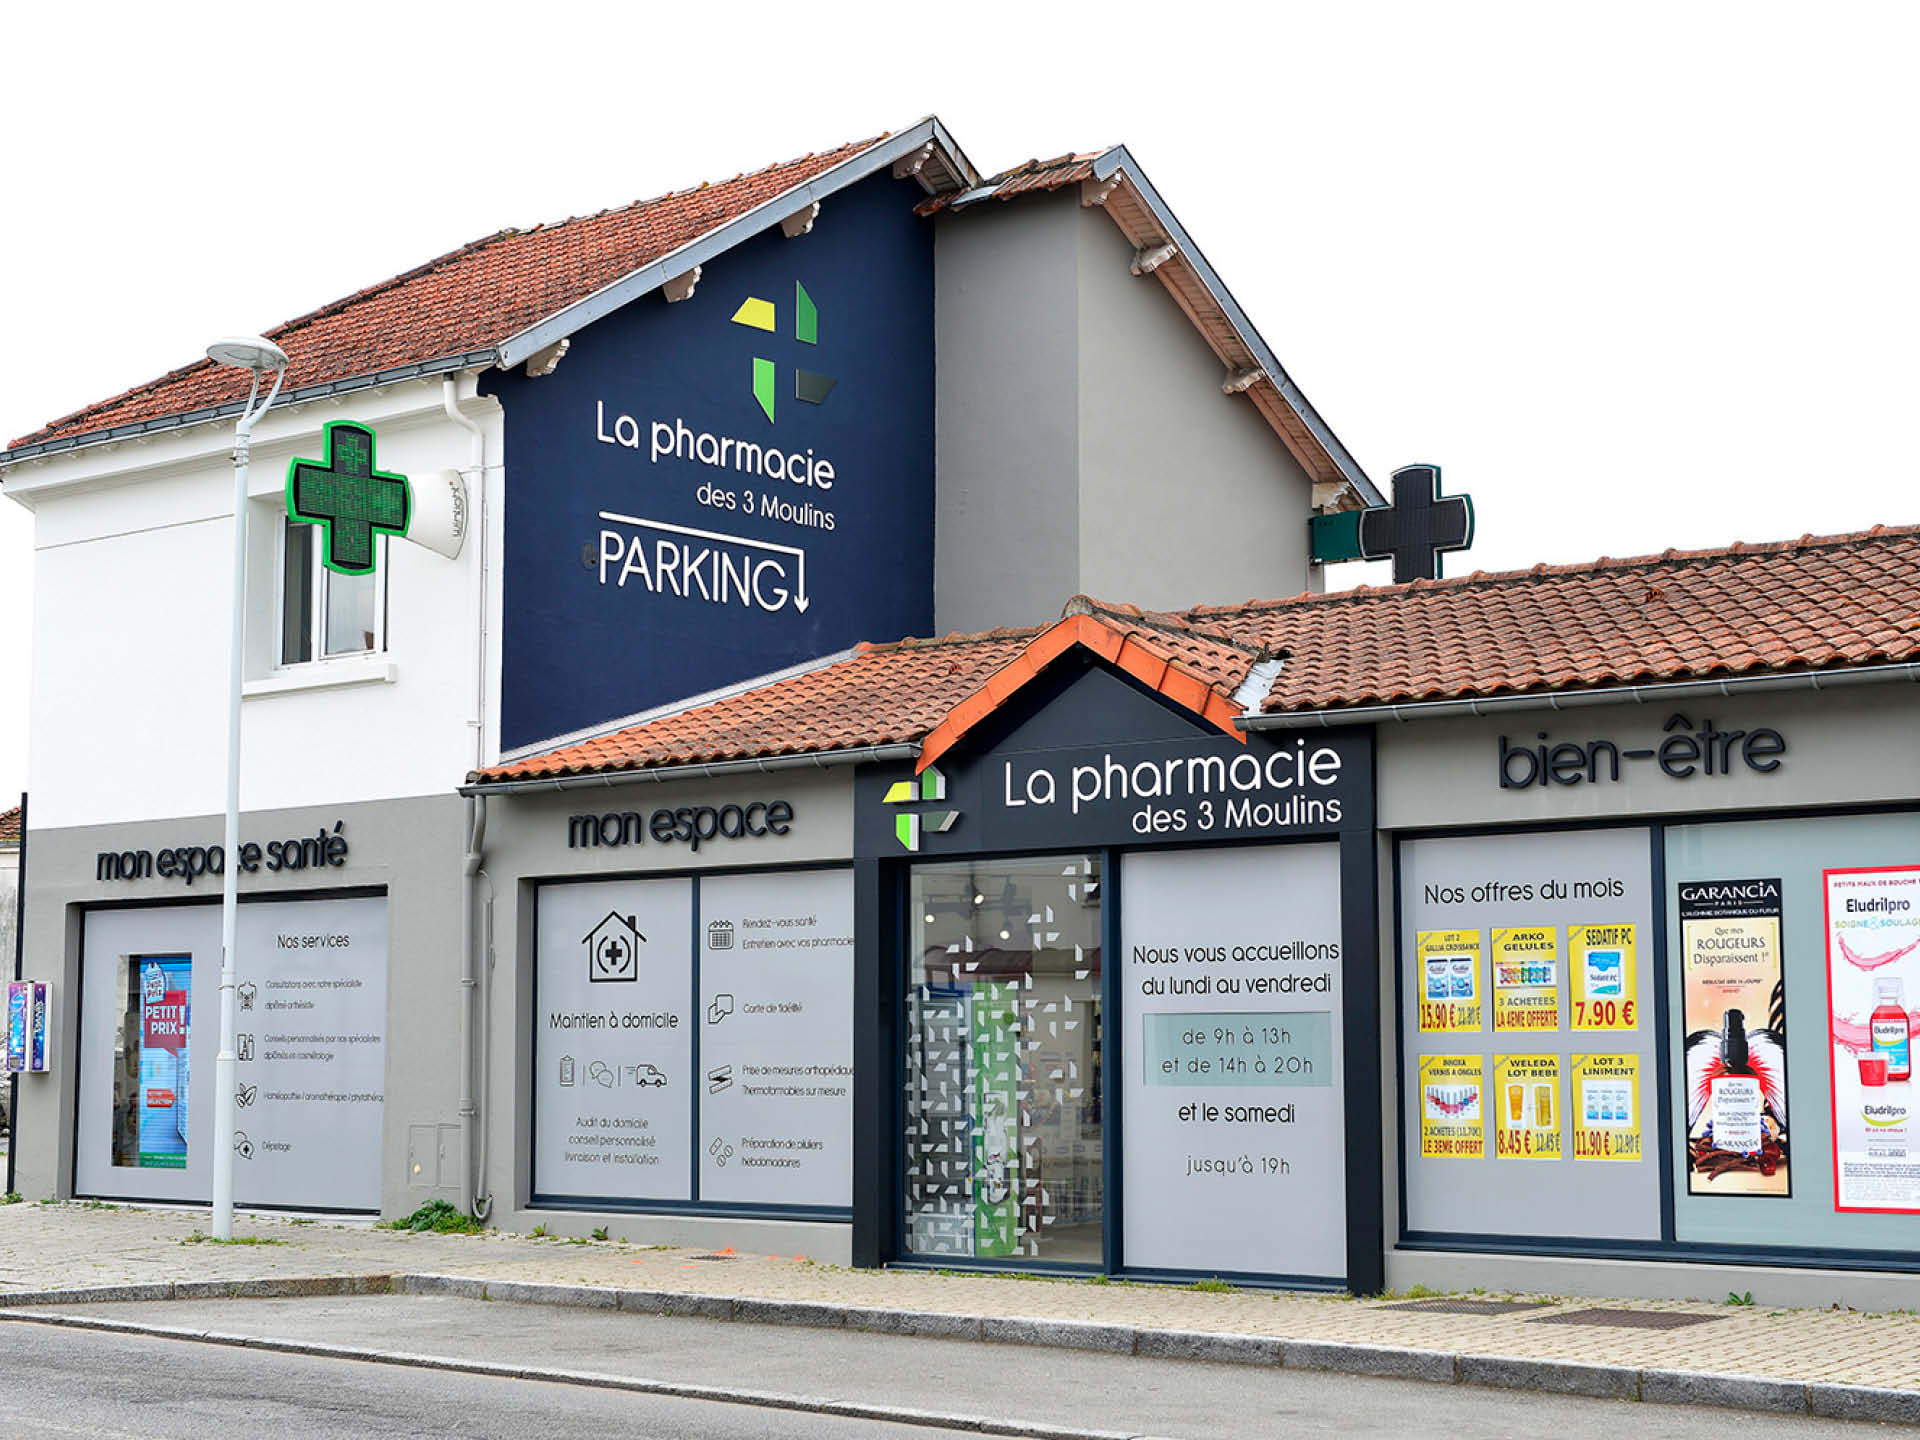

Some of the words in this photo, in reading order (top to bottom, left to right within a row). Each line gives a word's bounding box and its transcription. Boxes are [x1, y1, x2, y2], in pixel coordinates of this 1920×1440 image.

[597, 400, 639, 449] La
[650, 418, 836, 490] pharmacie
[697, 482, 736, 511] des
[743, 491, 755, 514] 3
[761, 494, 835, 531] Moulins
[600, 530, 788, 612] PARKING
[1499, 713, 1787, 789] bien-être
[1005, 761, 1055, 807] La
[1072, 738, 1342, 815] pharmacie
[1132, 804, 1187, 834] des
[1197, 801, 1215, 830] 3
[1225, 794, 1343, 829] Moulins
[568, 812, 642, 848] mon
[650, 800, 794, 851] espace
[97, 849, 152, 880] mon
[156, 842, 262, 885] espae
[266, 820, 348, 871] santé
[1424, 884, 1465, 905] Nos
[1471, 881, 1534, 903] offres
[1540, 879, 1567, 900] du
[1574, 877, 1625, 898] mois
[1846, 897, 1911, 915] Eludrilpro
[277, 934, 299, 949] Nos
[301, 933, 350, 948] services
[1504, 942, 1554, 951] GELULES
[1513, 933, 1545, 941] ARKO
[1586, 928, 1619, 946] SEDATIF
[1621, 927, 1632, 945] PC
[1697, 937, 1766, 950] ROUGEURS
[1133, 945, 1179, 964] Nous
[1184, 945, 1227, 963] vous
[1232, 941, 1340, 962] accueillons
[1141, 977, 1165, 995] du
[1169, 976, 1211, 994] lundi
[1216, 978, 1241, 994] au
[1245, 973, 1332, 993] vendredi
[1507, 997, 1556, 1006] ACHETEES
[146, 1005, 177, 1019] PETIT
[550, 1012, 605, 1029] Maintien
[608, 1011, 618, 1029] à
[622, 1012, 679, 1029] domicile
[1421, 1003, 1448, 1028] 15.90
[1449, 1003, 1456, 1028] €
[1496, 1011, 1505, 1028] LA
[1507, 1011, 1525, 1027] 4EME
[1527, 1010, 1558, 1028] OFFERTE
[1576, 1000, 1616, 1026] 7.90
[1622, 1000, 1634, 1026] €
[151, 1021, 177, 1035] PRIX
[1182, 1029, 1206, 1045] de
[1213, 1028, 1235, 1045] 9h
[1242, 1025, 1254, 1044] à
[1261, 1028, 1291, 1044] 13h
[1161, 1057, 1179, 1074] et
[1187, 1057, 1211, 1074] de
[1219, 1057, 1248, 1073] 14h
[1254, 1054, 1266, 1073] à
[1274, 1057, 1313, 1074] 20h
[1510, 1059, 1555, 1067] WELEDA
[1593, 1057, 1615, 1065] LOT
[1617, 1057, 1624, 1065] 3
[1507, 1069, 1528, 1077] LOT
[1531, 1069, 1558, 1077] BEBE
[1582, 1067, 1635, 1076] LINIMENT
[1178, 1103, 1197, 1121] et
[1202, 1103, 1219, 1122] le
[1224, 1103, 1296, 1123] samedi
[1864, 1105, 1906, 1117] Eludrilpro
[576, 1117, 598, 1128] Audit
[600, 1117, 610, 1128] du
[1424, 1140, 1432, 1153] LE
[1434, 1140, 1453, 1153] 3EME
[1455, 1140, 1483, 1154] OFFERT
[1498, 1130, 1521, 1154] 8.45
[1524, 1130, 1531, 1154] €
[1575, 1131, 1602, 1155] 11.90
[1604, 1131, 1610, 1155] €
[1186, 1155, 1254, 1177] jusqu'à
[1261, 1157, 1291, 1175] 19h
